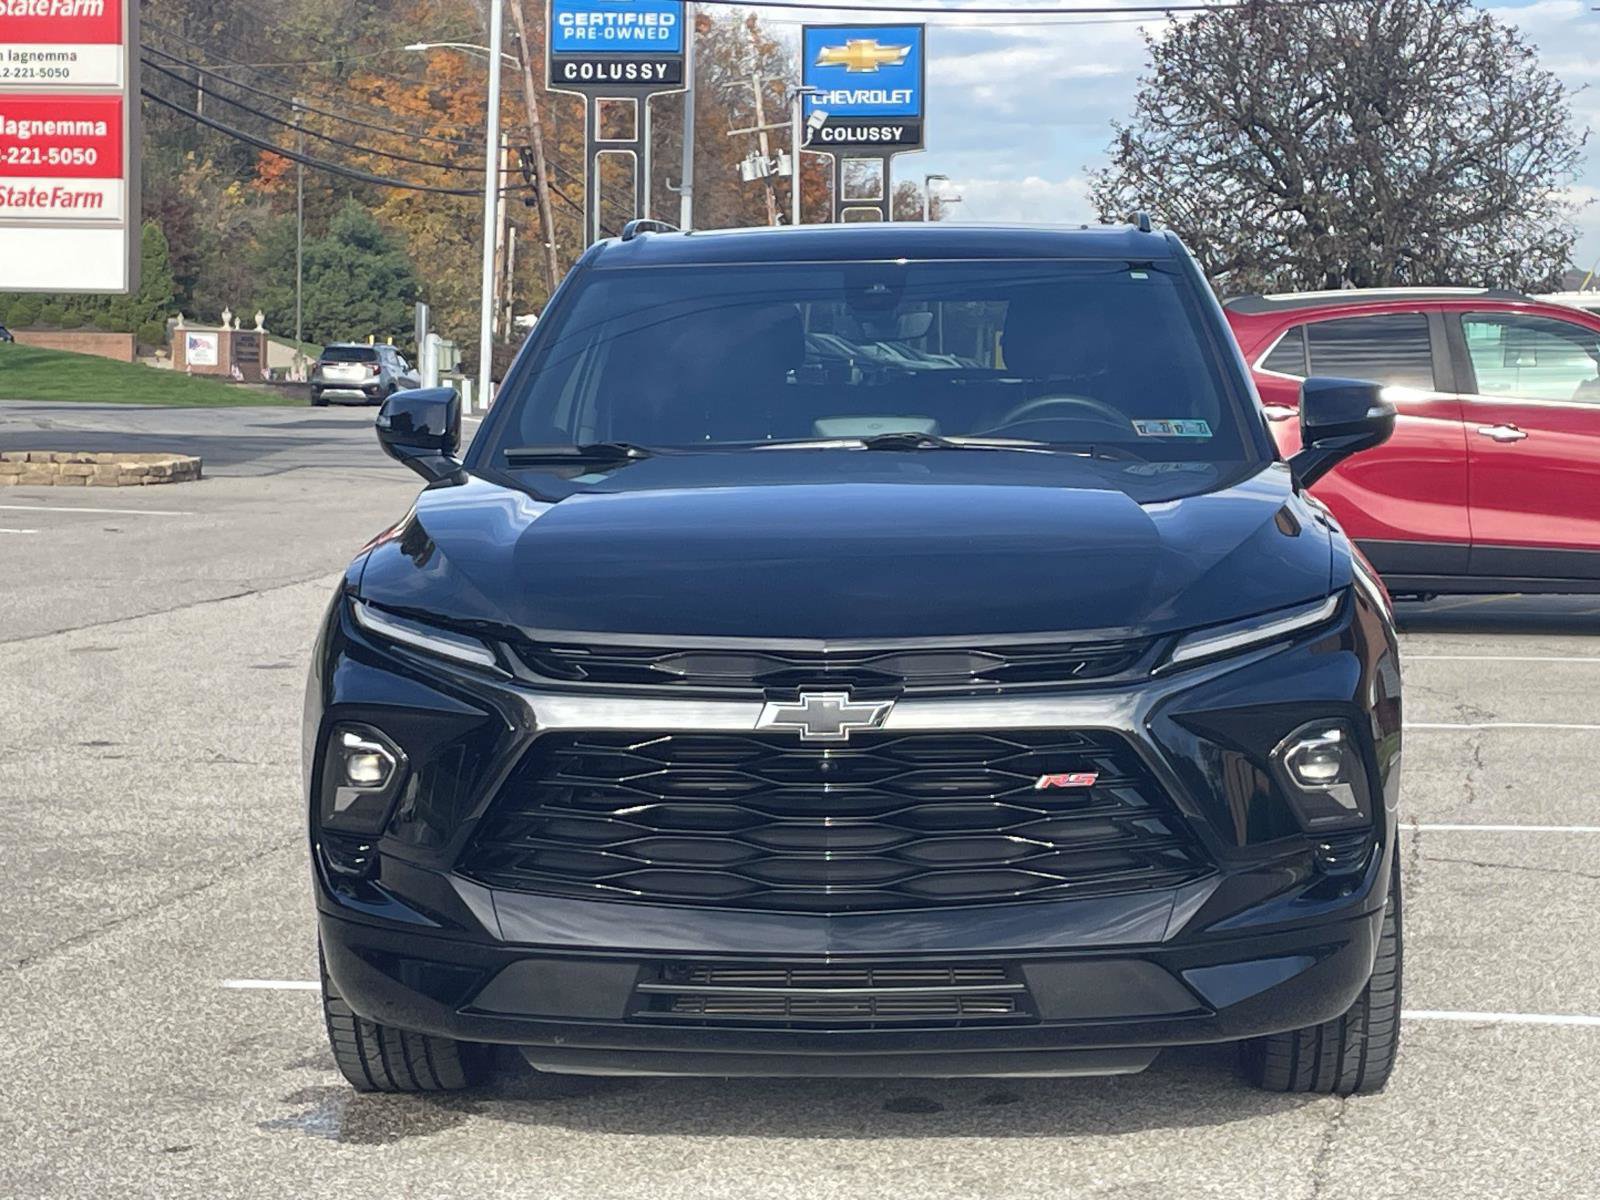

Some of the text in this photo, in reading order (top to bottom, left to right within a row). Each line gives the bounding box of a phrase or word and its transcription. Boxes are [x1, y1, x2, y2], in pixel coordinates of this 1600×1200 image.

[559, 12, 676, 26] CERTIFIED
[564, 27, 669, 40] PRE-OWNED
[0, 67, 70, 78] 2-221-5050
[564, 63, 668, 80] COLUSSY
[812, 89, 913, 105] CHEVROLET
[821, 126, 904, 141] COLUSSY
[0, 146, 97, 166] -221-5050
[1035, 772, 1099, 790] RS
